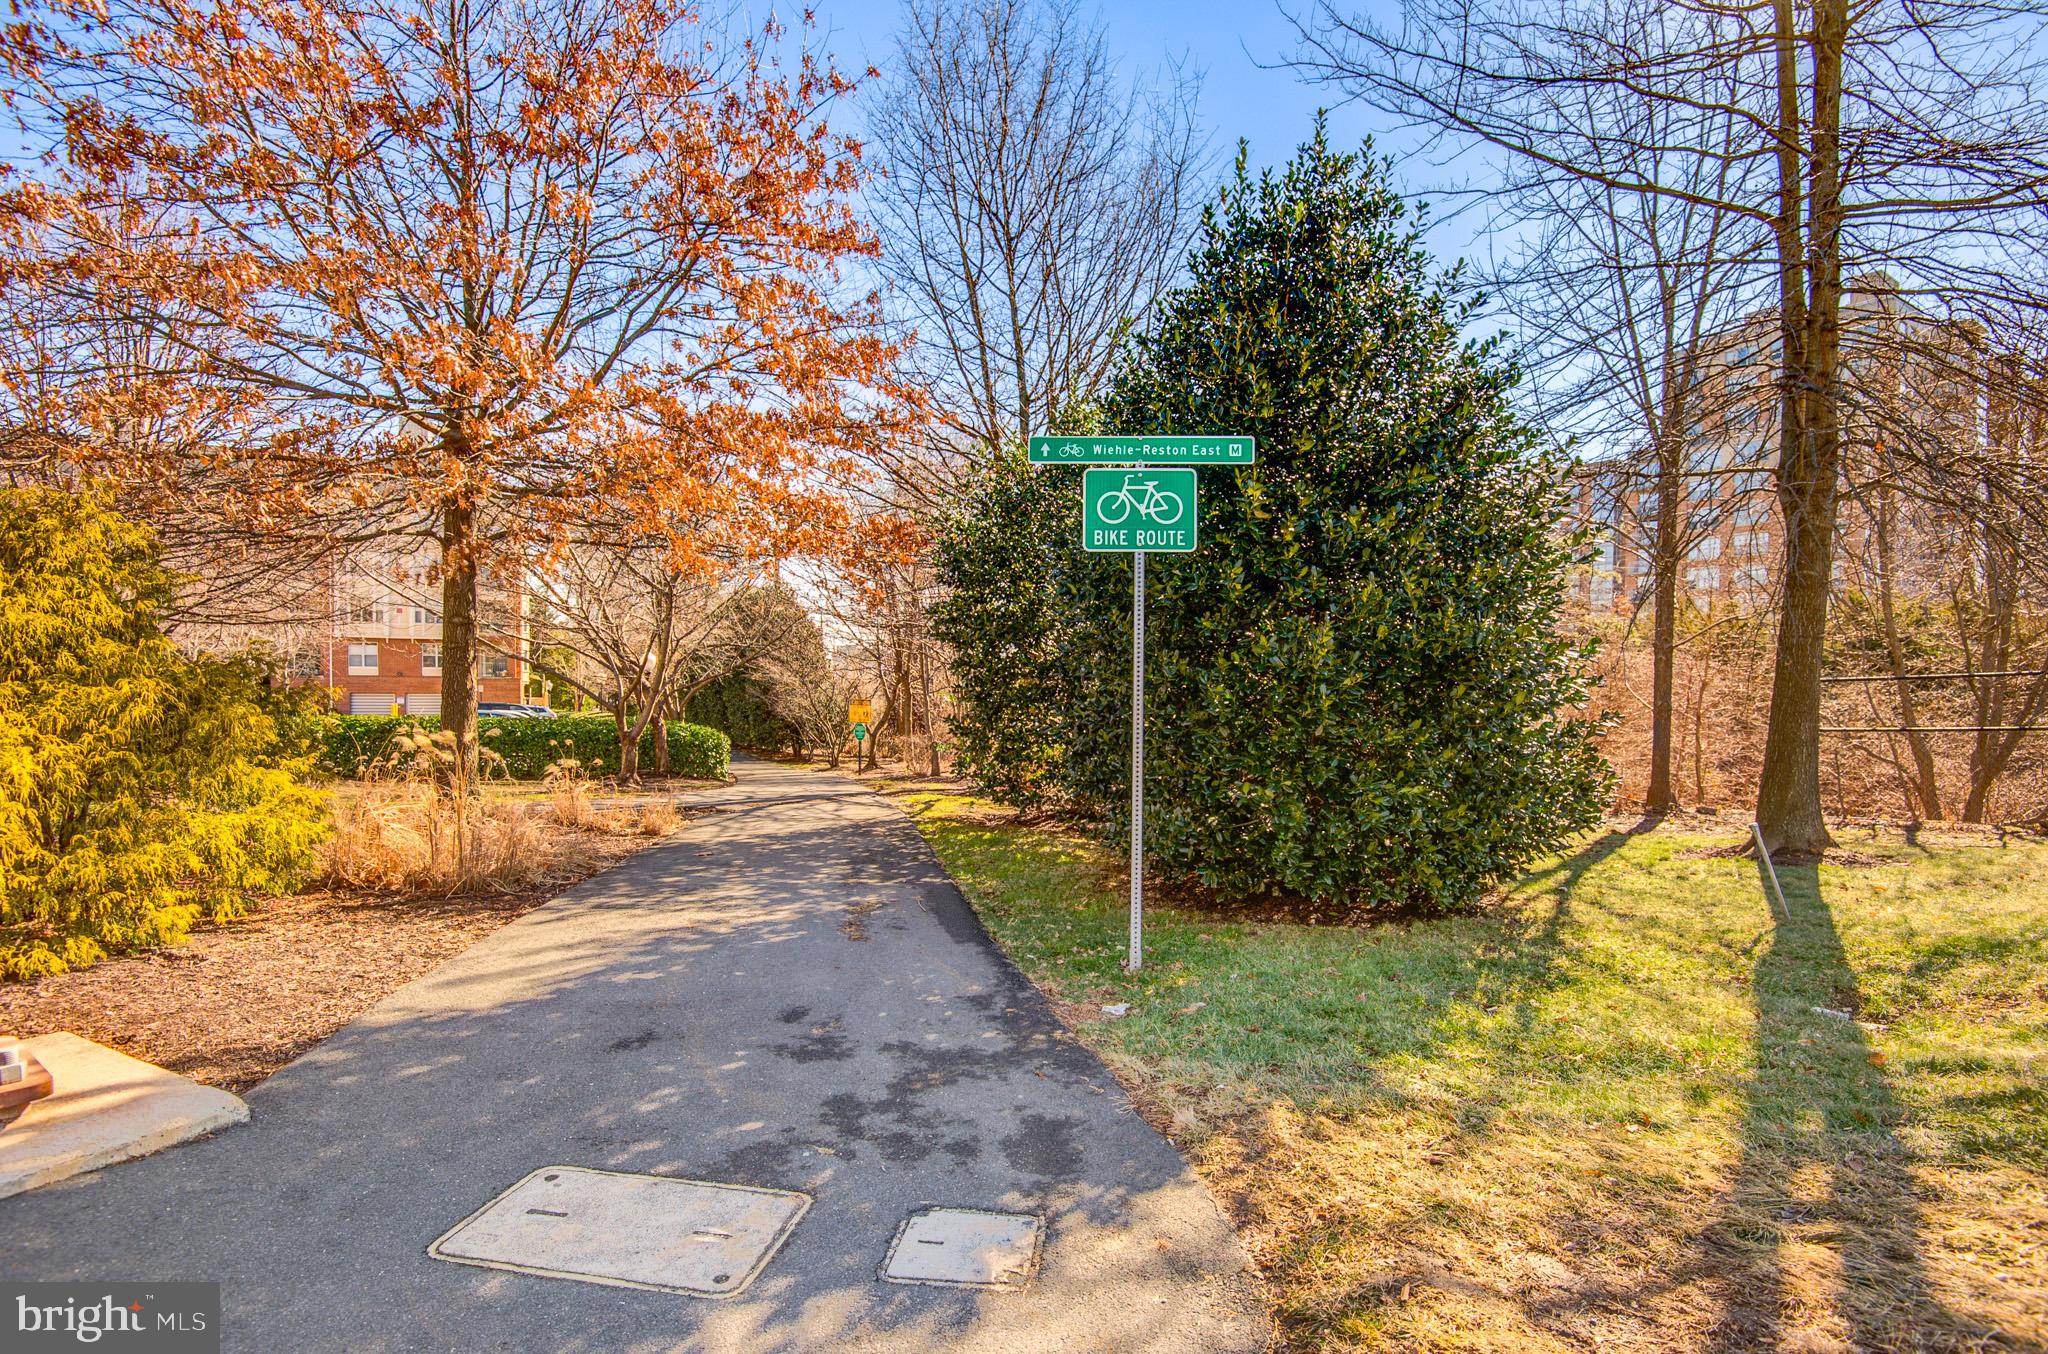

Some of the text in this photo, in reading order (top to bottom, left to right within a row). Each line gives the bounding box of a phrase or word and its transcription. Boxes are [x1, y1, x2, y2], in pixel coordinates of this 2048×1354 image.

[1092, 444, 1242, 456] Wiehle-Reston East M
[1094, 530, 1186, 545] BIKE ROUTE
